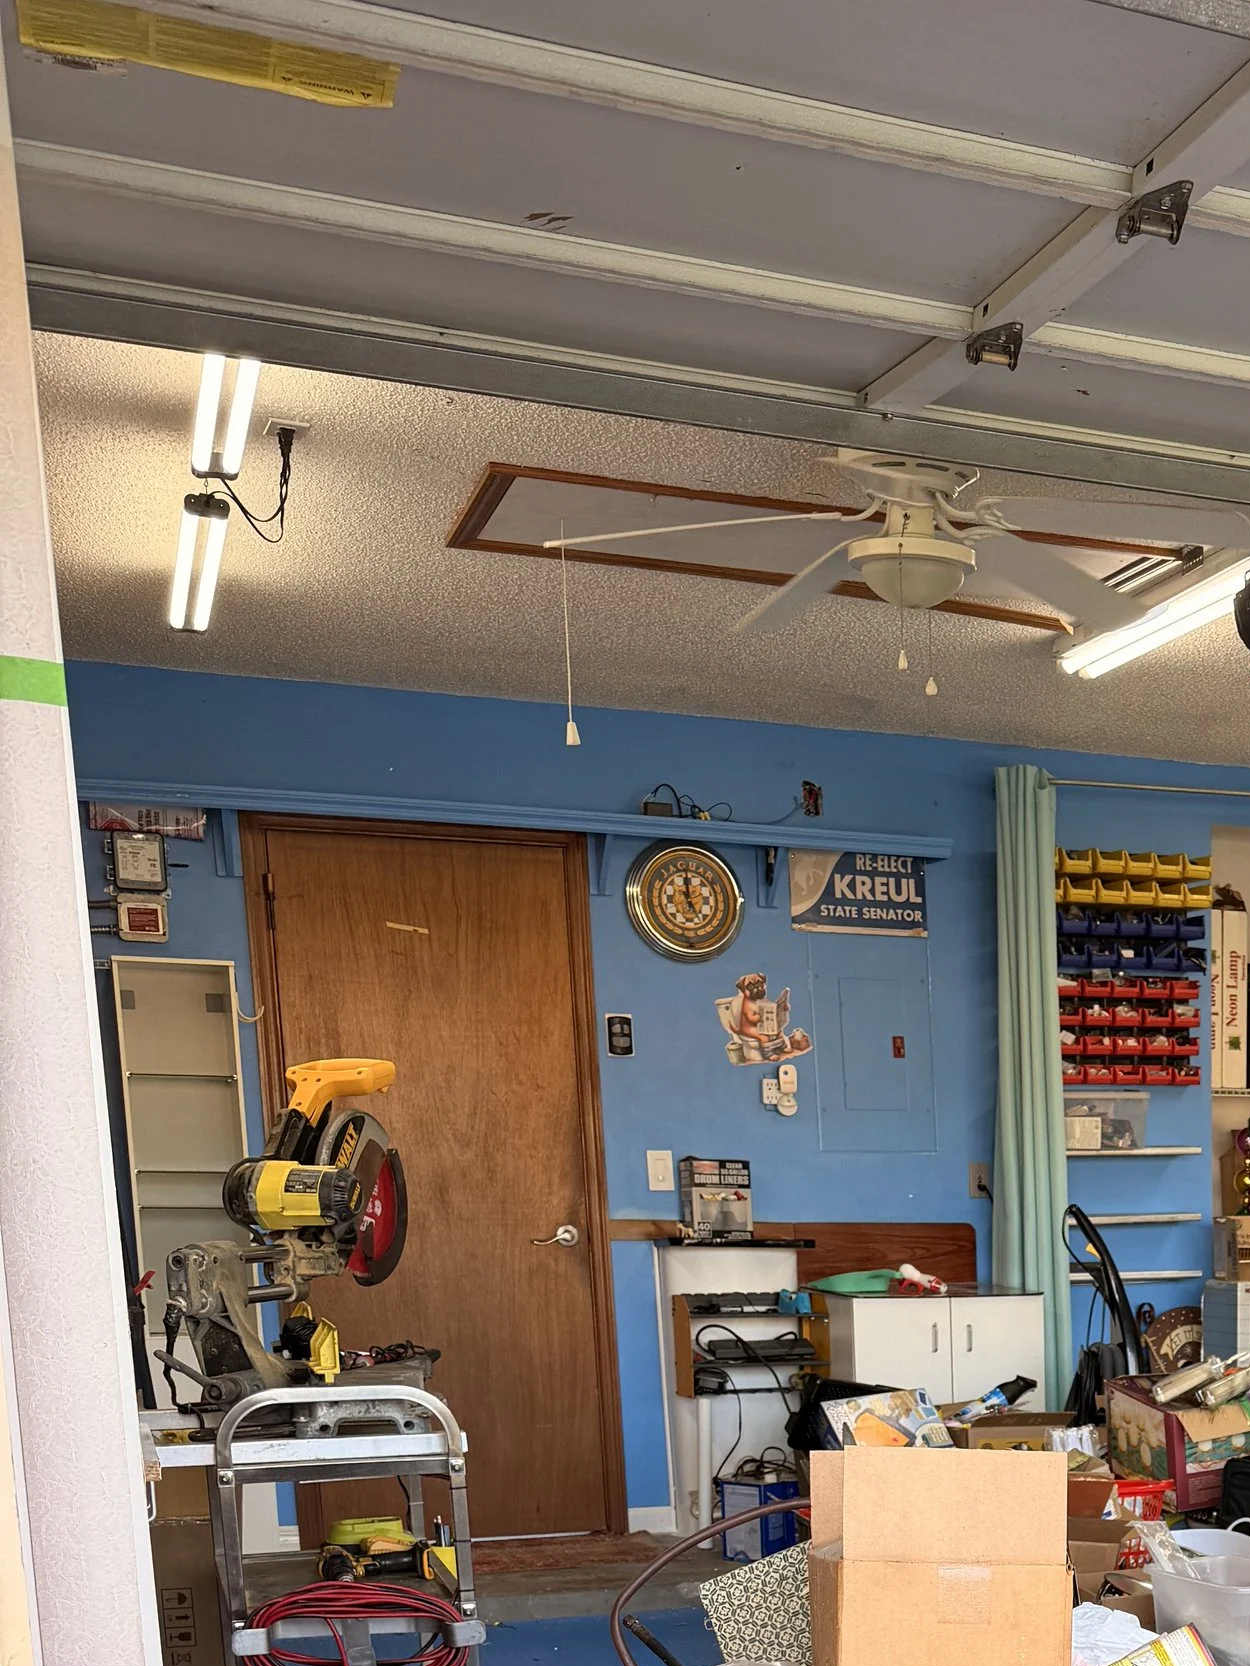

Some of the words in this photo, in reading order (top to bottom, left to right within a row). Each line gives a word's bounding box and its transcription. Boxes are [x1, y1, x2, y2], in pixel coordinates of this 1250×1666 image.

[661, 861, 713, 881] JAGUAR
[855, 854, 913, 873] RE-ELECT
[834, 873, 923, 904] KREUL
[820, 904, 859, 919] STATE
[862, 907, 923, 923] SENATOR
[1226, 950, 1242, 989] Lamp
[1225, 993, 1239, 1028] Neon
[336, 1121, 358, 1169] WALT
[693, 1173, 720, 1184] DRUM
[720, 1174, 749, 1186] LINERS
